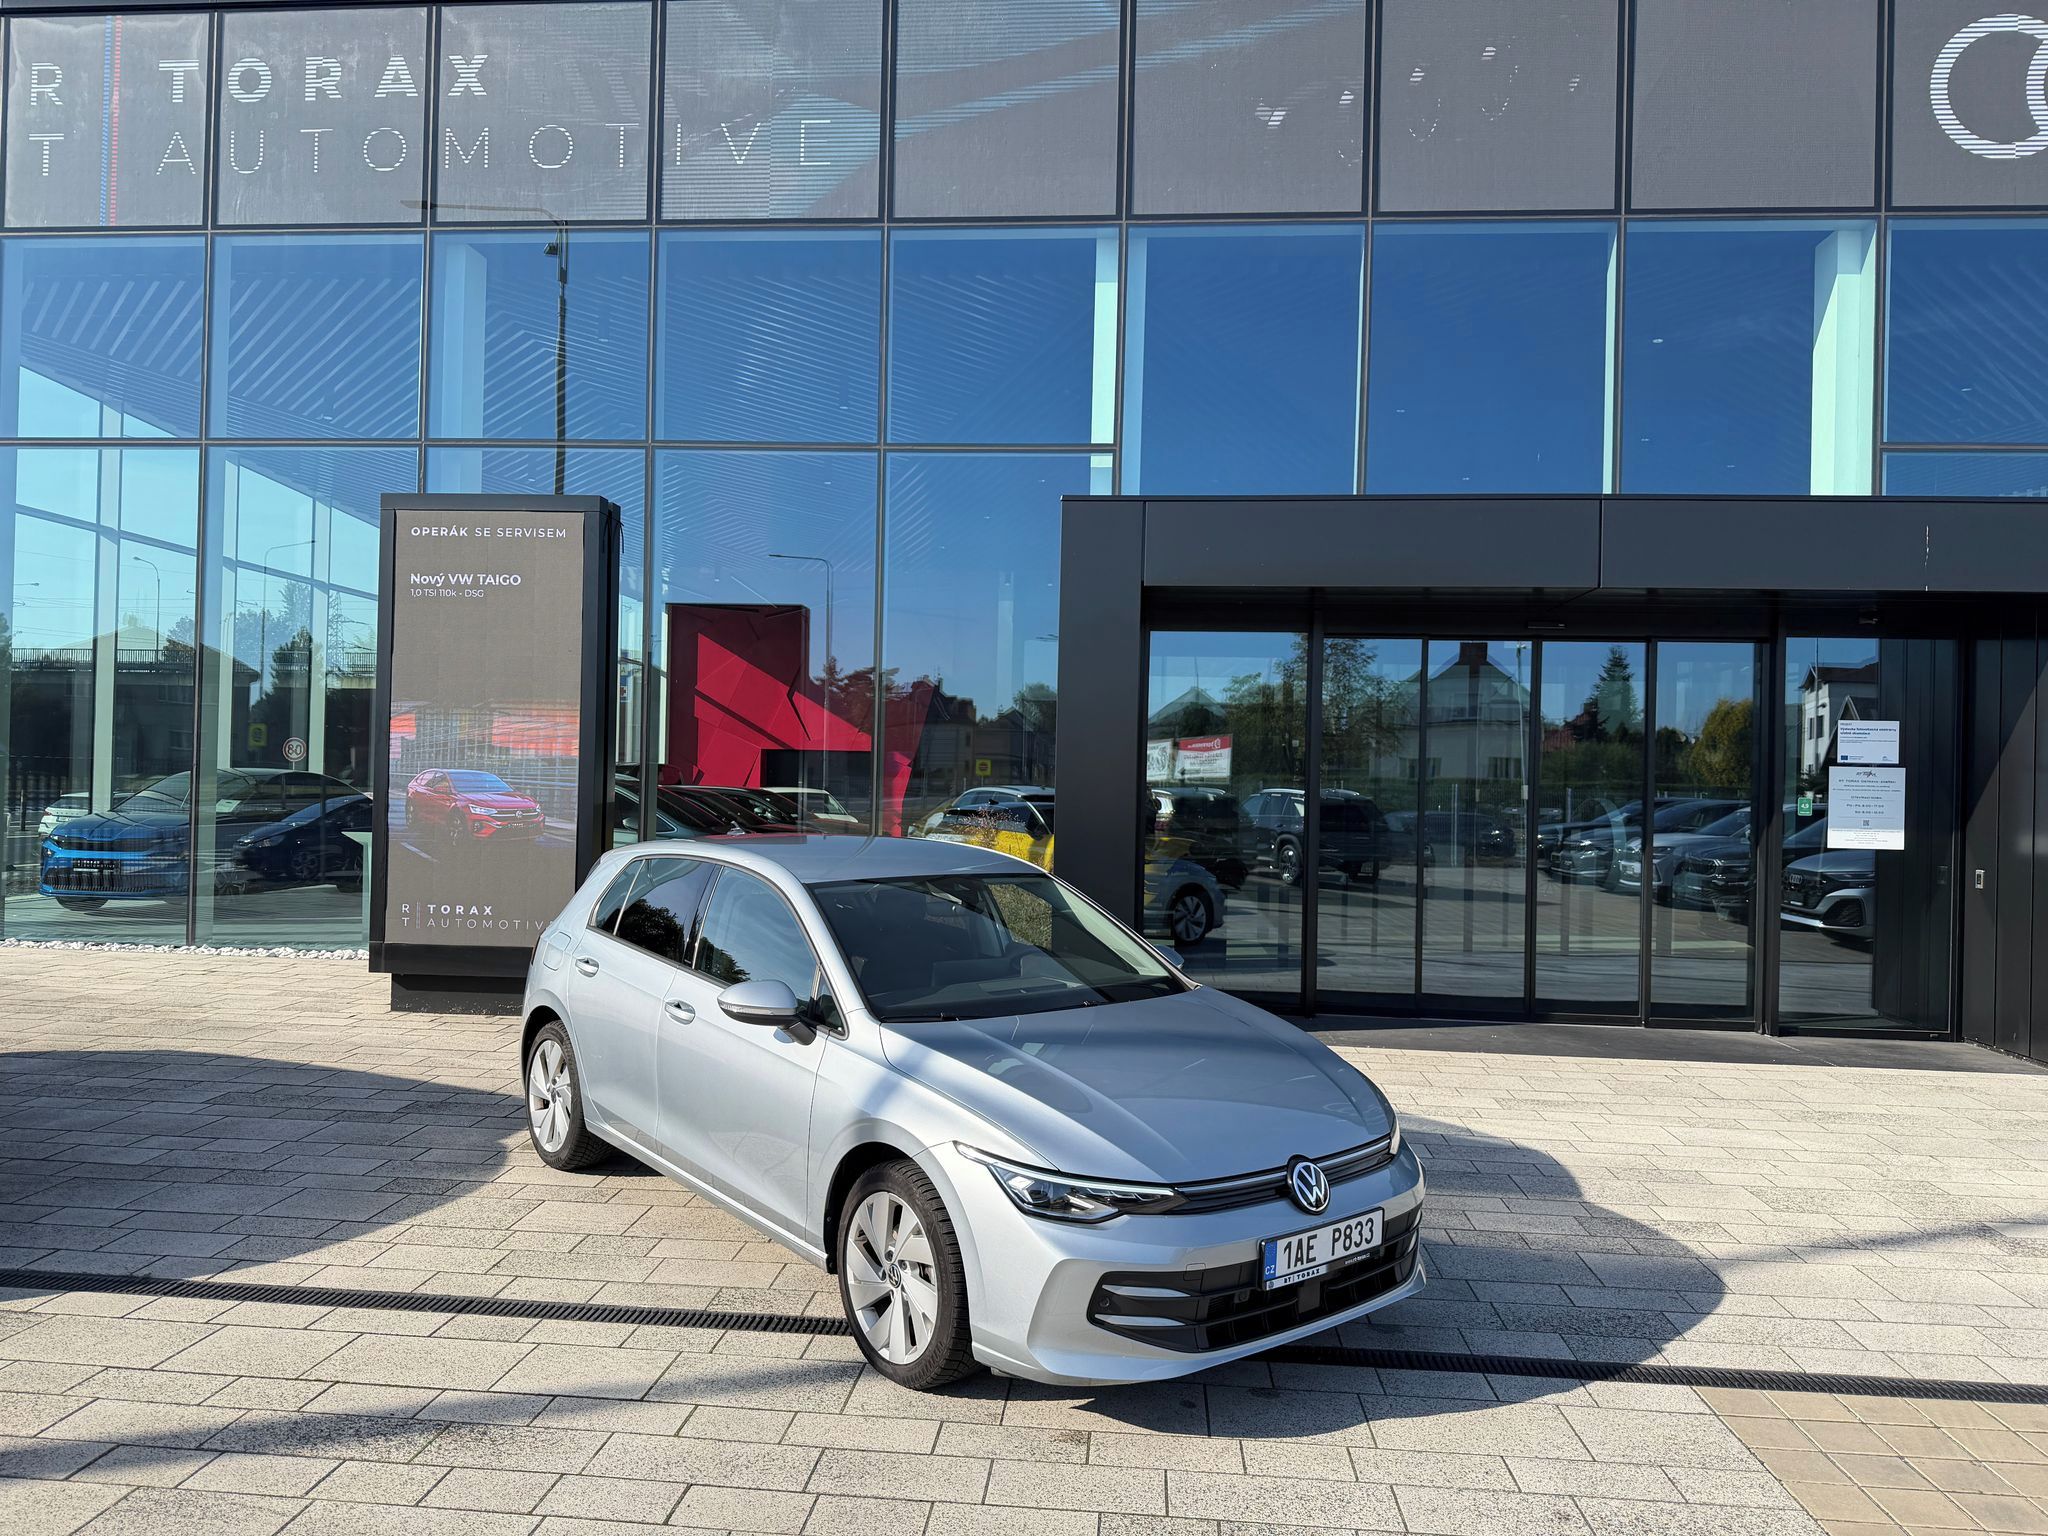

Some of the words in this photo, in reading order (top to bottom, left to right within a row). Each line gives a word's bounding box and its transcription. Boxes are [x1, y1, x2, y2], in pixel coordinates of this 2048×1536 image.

[30, 62, 63, 105] R
[158, 54, 489, 104] TORAX
[28, 133, 65, 176] T
[156, 119, 831, 174] AUTOMOTIVE
[410, 525, 469, 537] OPERÁK
[474, 527, 491, 537] SE
[496, 528, 567, 539] SERVISEM
[410, 572, 444, 587] Nový
[448, 574, 473, 585] VW
[477, 574, 521, 586] TAIGO
[410, 588, 421, 598] 1,0
[422, 589, 437, 597] TSI
[438, 588, 457, 598] 110k
[464, 589, 484, 598] DSG
[401, 903, 411, 914] R
[427, 904, 493, 916] TORAX
[401, 917, 411, 927] T
[427, 918, 553, 930] AUTOMOTIV
[1283, 1234, 1318, 1269] 1AE
[1331, 1217, 1374, 1256] P833
[1264, 1265, 1275, 1276] CZ
[1283, 1276, 1293, 1285] RT
[1296, 1268, 1321, 1280] TORAX
